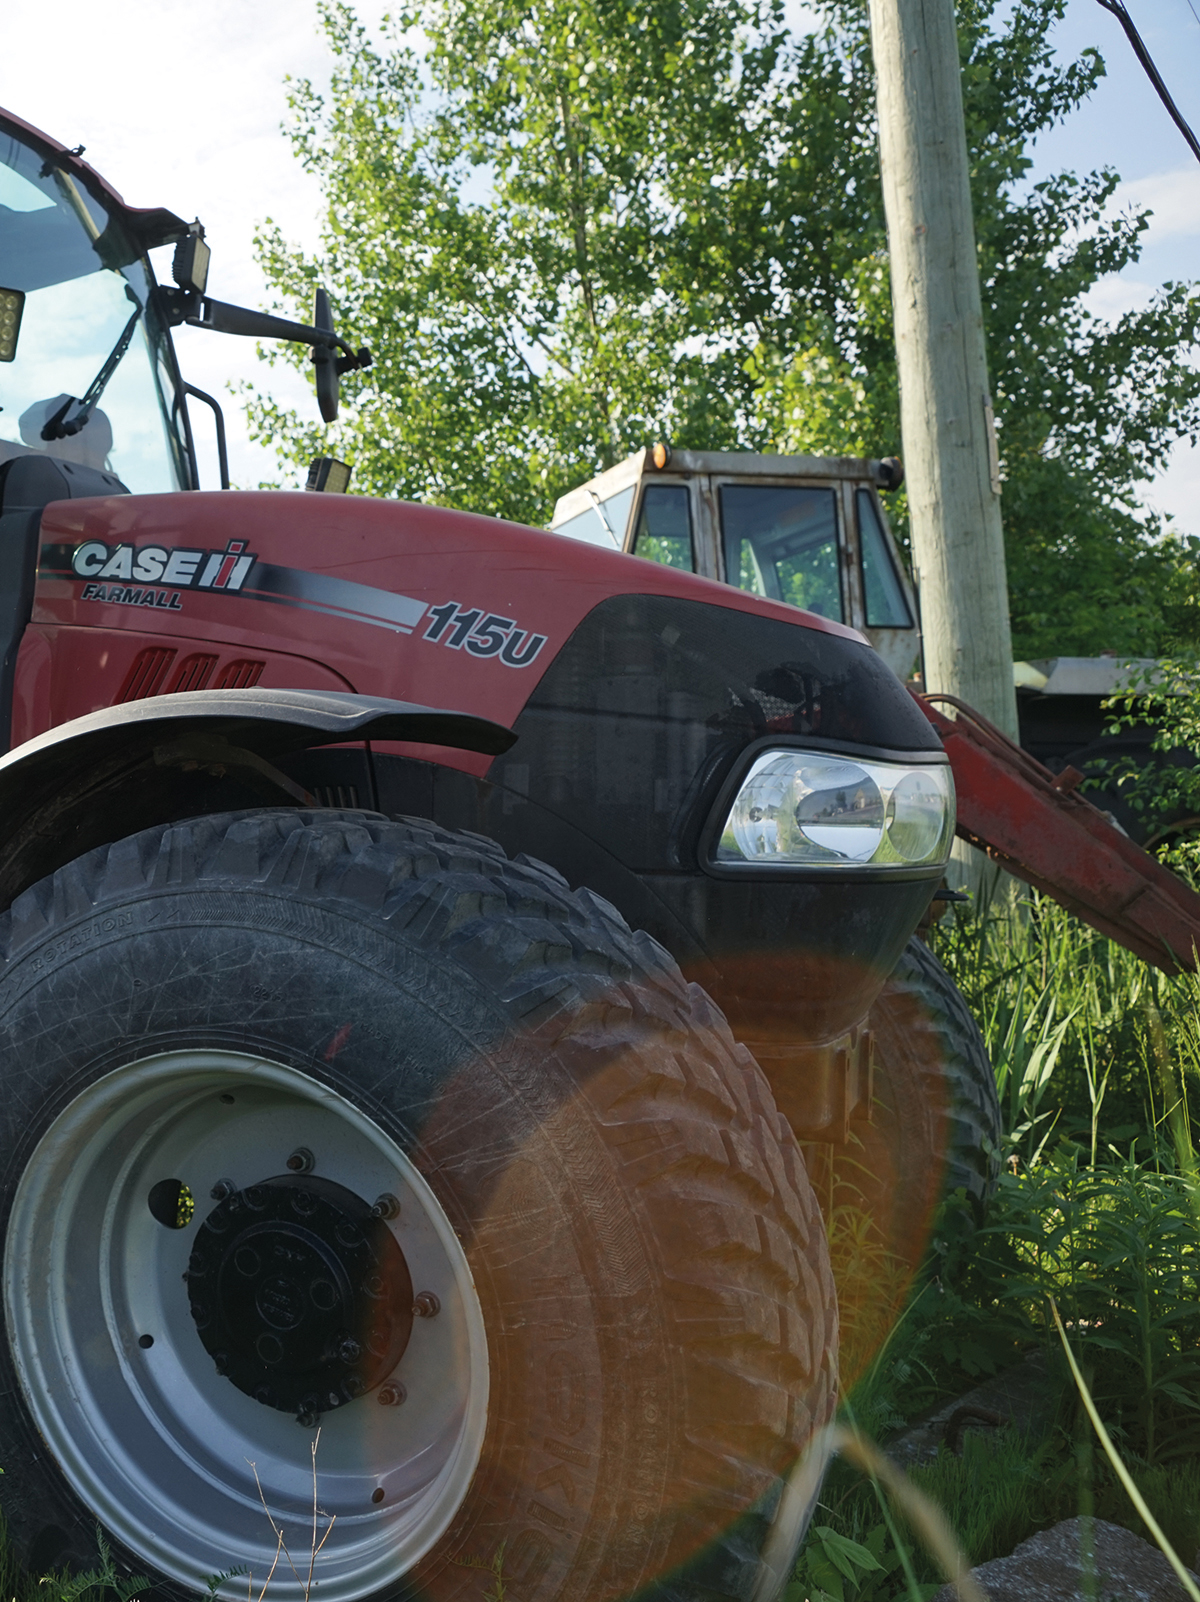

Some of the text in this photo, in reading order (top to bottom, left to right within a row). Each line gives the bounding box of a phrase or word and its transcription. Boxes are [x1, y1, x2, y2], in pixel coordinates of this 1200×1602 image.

[73, 541, 203, 586] CASE
[81, 583, 183, 611] FARMALL
[422, 600, 548, 668] 115U
[30, 910, 134, 973] ROTATION
